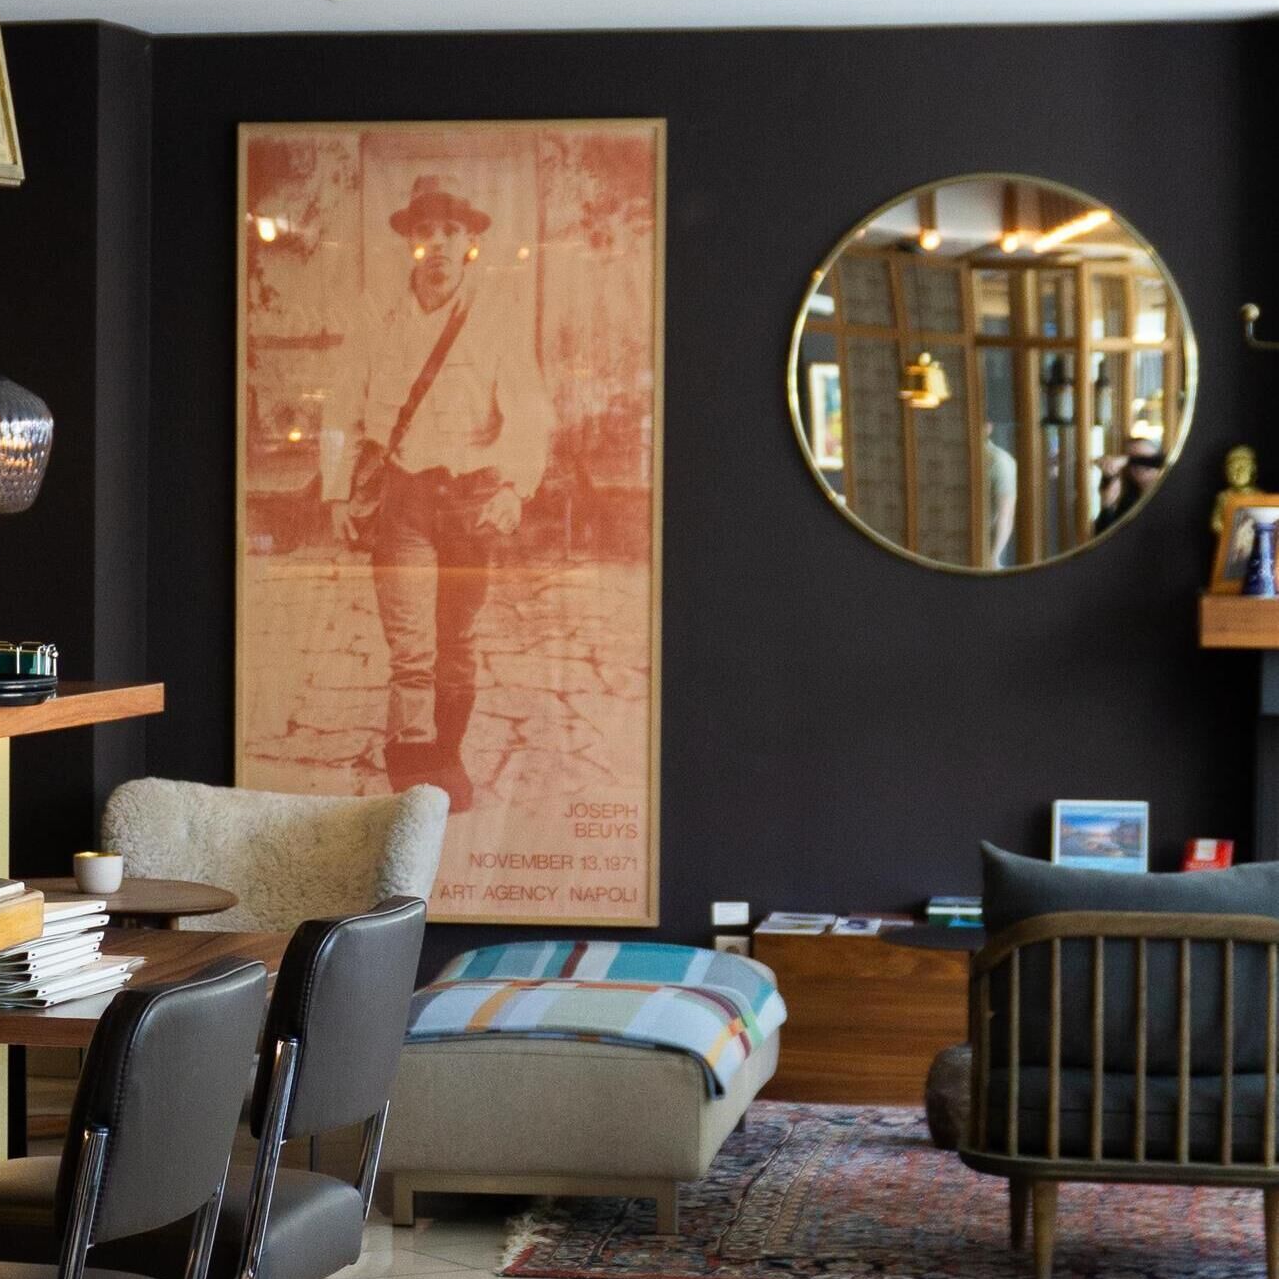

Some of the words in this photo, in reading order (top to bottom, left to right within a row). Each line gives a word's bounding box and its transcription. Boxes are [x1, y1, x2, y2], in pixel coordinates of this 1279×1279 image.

[564, 802, 639, 819] JOSEPH
[574, 822, 639, 839] BEUYS
[470, 852, 574, 870] NOVEMBER
[439, 884, 477, 900] ART
[483, 884, 559, 901] AGENCY
[570, 885, 638, 903] NAPOLI
